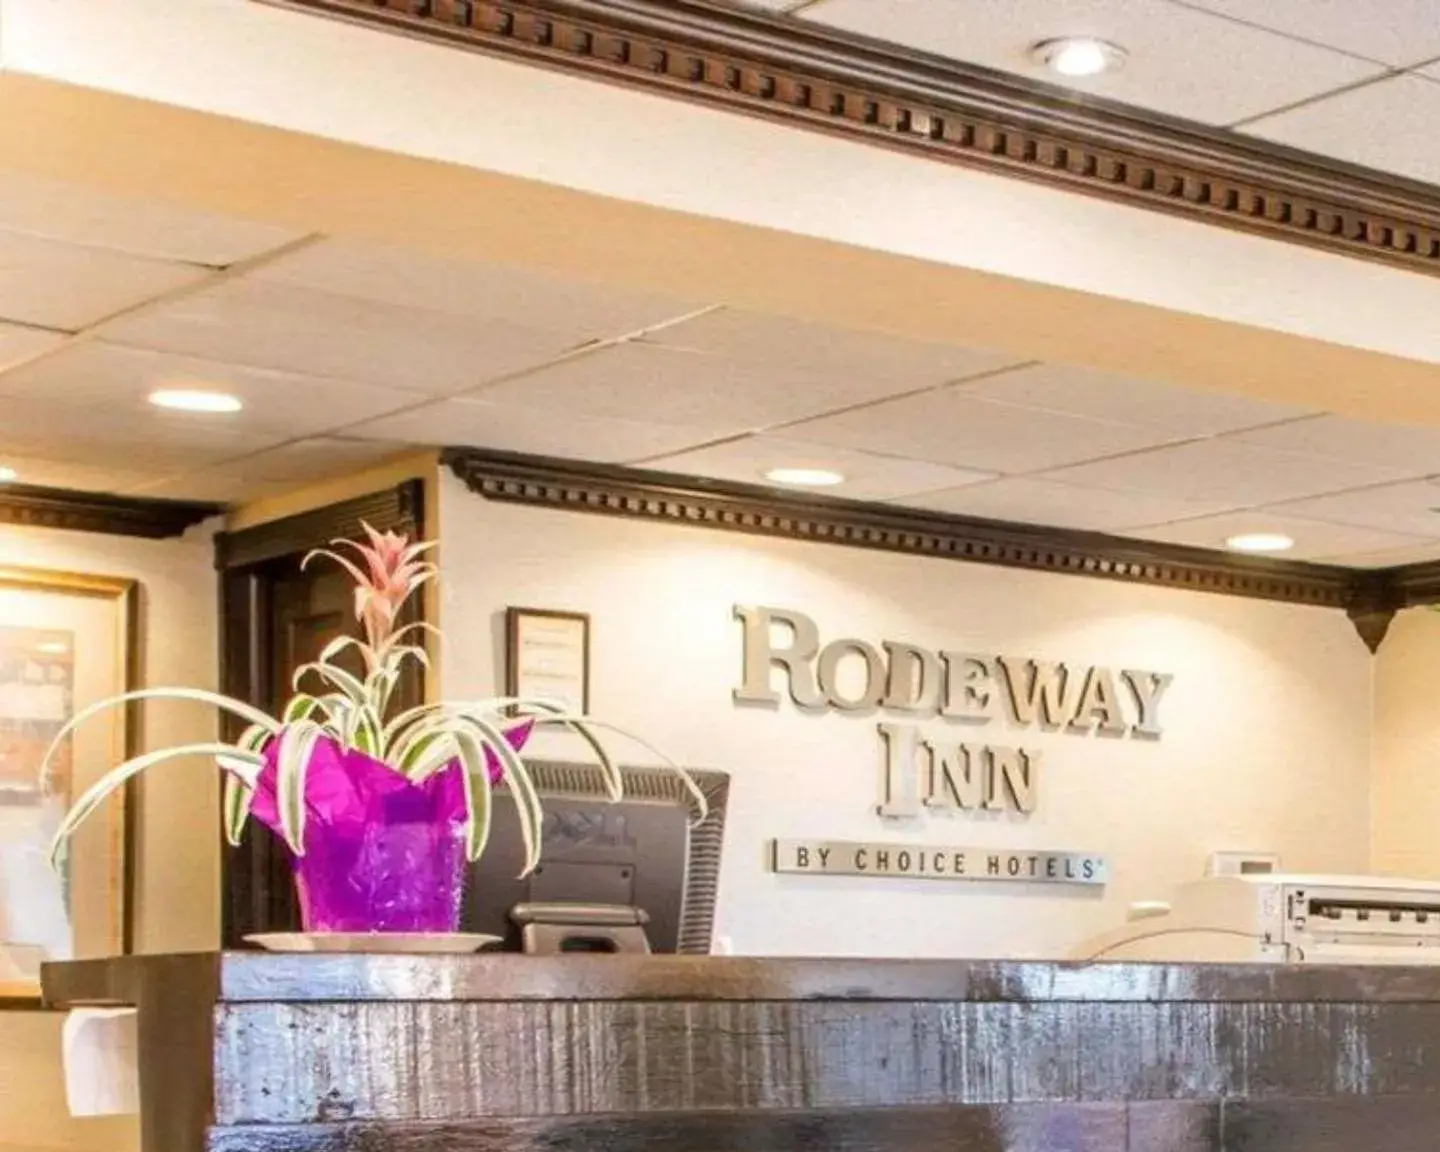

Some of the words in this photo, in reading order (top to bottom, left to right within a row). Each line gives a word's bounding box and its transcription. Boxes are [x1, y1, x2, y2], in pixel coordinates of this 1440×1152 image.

[733, 604, 1175, 740] RODEWAY
[876, 722, 1044, 821] INN
[797, 847, 830, 868] BY
[855, 850, 965, 874] CHOICE
[987, 855, 1094, 879] HOTELS
